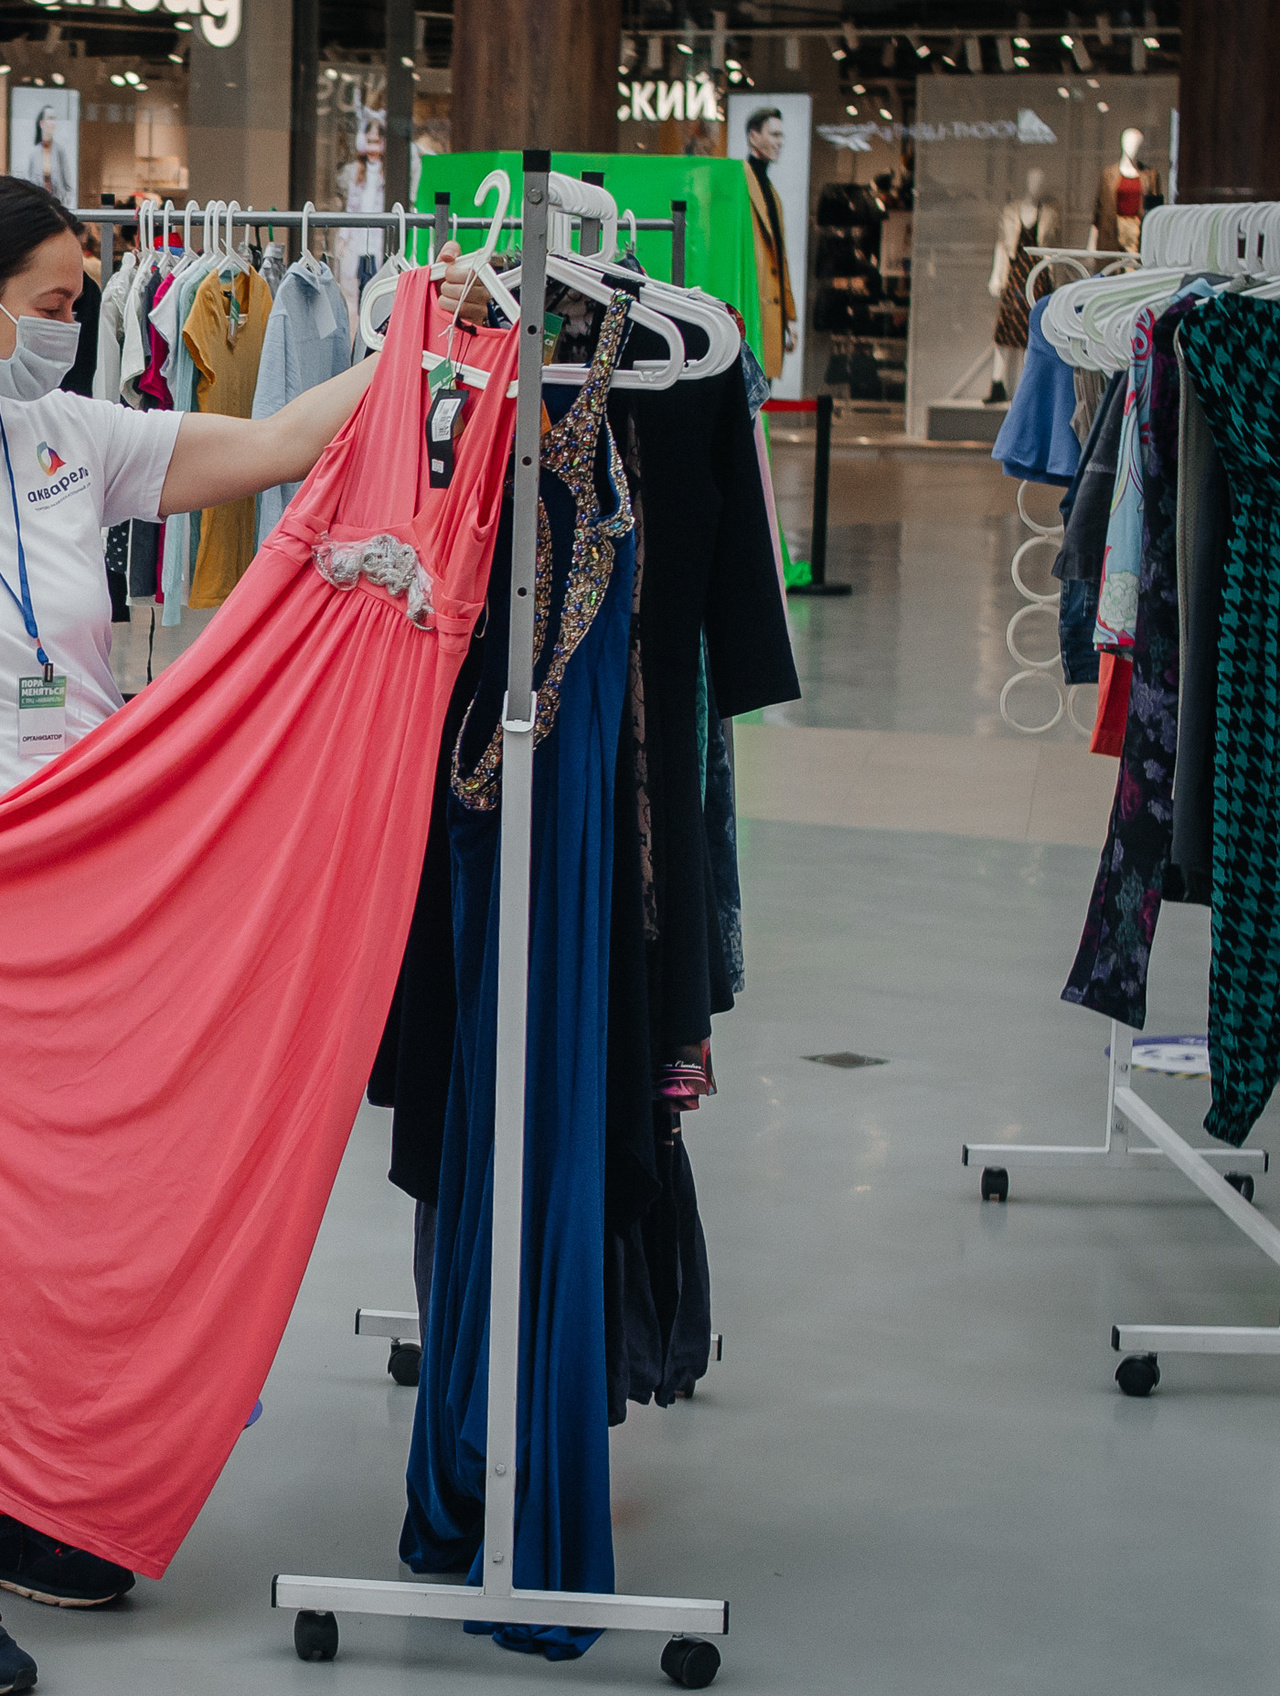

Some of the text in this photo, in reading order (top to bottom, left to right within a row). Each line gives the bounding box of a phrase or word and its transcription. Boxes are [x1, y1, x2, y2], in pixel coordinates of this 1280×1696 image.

[21, 679, 44, 688] ПОРА
[21, 686, 65, 697] МЕНЯТЬСЯ
[22, 734, 63, 742] ОРГАНИЗАТОР
